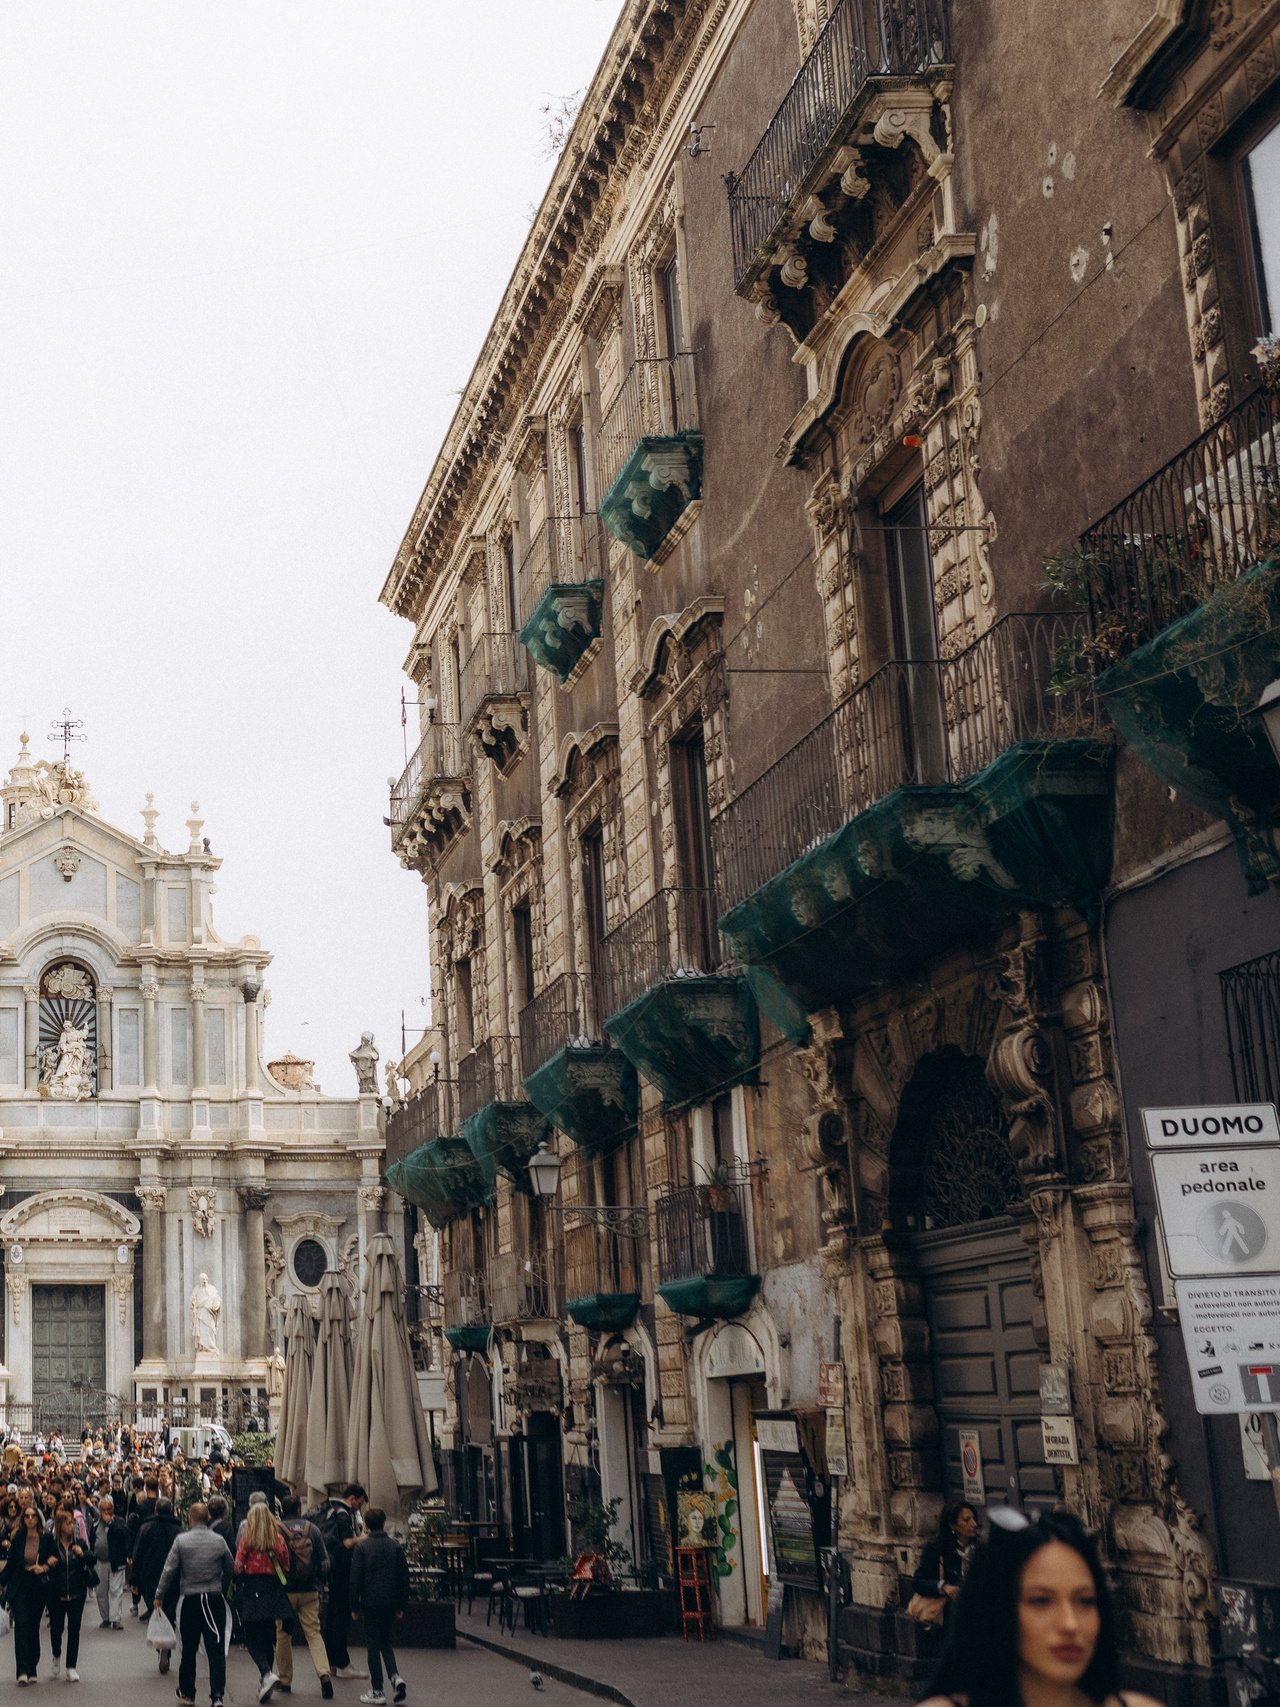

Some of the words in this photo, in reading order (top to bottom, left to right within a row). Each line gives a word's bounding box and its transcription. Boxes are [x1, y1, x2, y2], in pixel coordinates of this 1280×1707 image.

[1160, 1115, 1264, 1137] DUOMO
[1200, 1161, 1239, 1173] area
[1181, 1177, 1266, 1196] pedonale
[1187, 1291, 1221, 1299] DIVIETO
[1234, 1289, 1276, 1297] TRANSITO
[1195, 1301, 1236, 1309] autoveicoli
[1196, 1310, 1240, 1319] motoveicoli
[1047, 1449, 1071, 1458] DENTISTA
